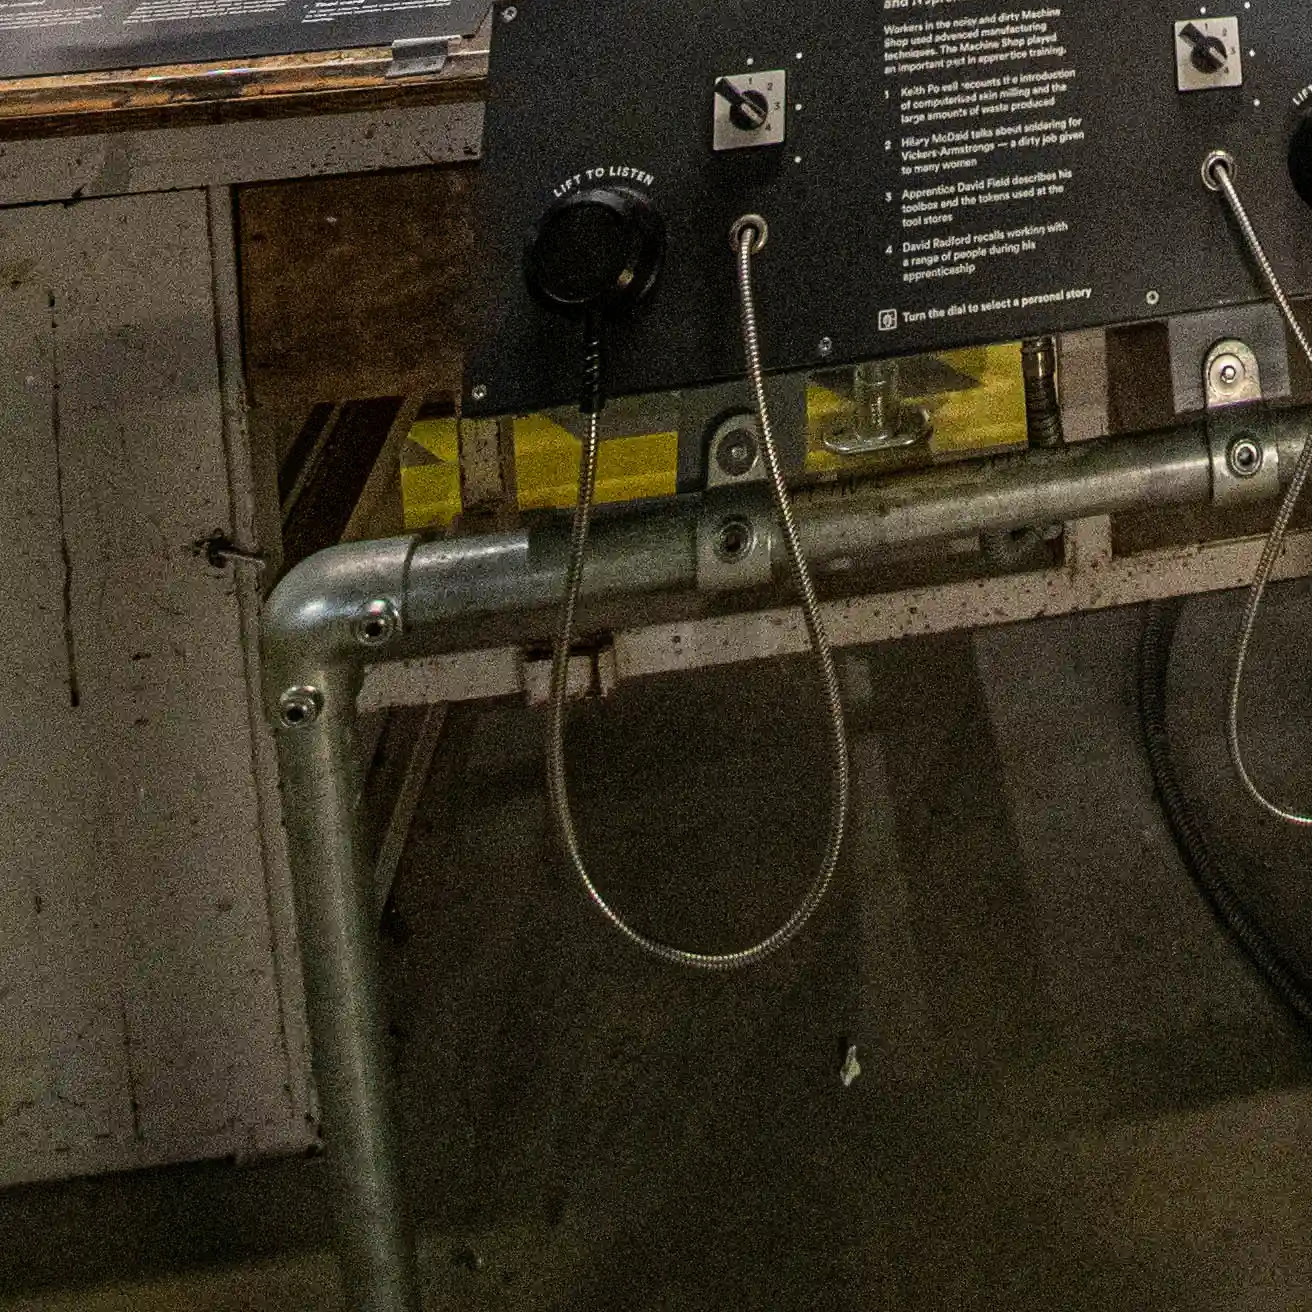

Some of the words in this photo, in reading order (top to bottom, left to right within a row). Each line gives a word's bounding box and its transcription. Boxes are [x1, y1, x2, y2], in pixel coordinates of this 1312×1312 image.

[883, 23, 923, 34] Workers
[924, 20, 934, 30] in
[935, 20, 951, 29] the
[978, 13, 996, 24] and
[997, 12, 1020, 22] dirty
[1021, 7, 1060, 19] Machine
[884, 37, 908, 48] Shop
[910, 33, 932, 44] used
[934, 28, 979, 42] advanced
[980, 22, 1046, 36] manufacturing
[939, 44, 958, 54] The
[959, 39, 999, 52] Machine
[1001, 37, 1025, 47] Shop
[1026, 32, 1057, 46] played
[884, 65, 896, 74] an
[898, 58, 944, 73] important
[967, 54, 976, 64] in
[978, 49, 1027, 64] apprentice
[884, 90, 889, 99] 1
[900, 85, 925, 96] Keith
[1002, 74, 1017, 84] the
[1018, 68, 1075, 82] introduction
[900, 99, 911, 110] of
[978, 89, 997, 100] skin
[1031, 83, 1049, 94] and
[1051, 82, 1066, 92] the
[900, 113, 925, 124] large
[927, 107, 967, 120] amounts
[969, 104, 979, 115] of
[980, 102, 1008, 114] waste
[1010, 96, 1055, 112] produced
[884, 140, 892, 150] 2
[970, 127, 993, 139] talks
[994, 123, 1022, 136] about
[1068, 117, 1082, 127] for
[1010, 139, 1016, 147] a
[1017, 135, 1040, 146] dirty
[1041, 132, 1057, 146] job
[1058, 131, 1084, 143] given
[900, 166, 912, 174] to
[913, 162, 940, 173] many
[941, 158, 977, 169] women
[553, 174, 581, 197] LIFT
[585, 167, 605, 180] TO
[609, 166, 654, 186] LISTEN
[885, 192, 892, 202] 3
[901, 183, 955, 200] Apprentice
[957, 179, 984, 192] David
[1011, 171, 1056, 185] describes
[1058, 168, 1072, 178] his
[901, 201, 938, 213] toolbox
[940, 195, 958, 208] and
[960, 195, 976, 205] the
[978, 191, 1010, 203] tokens
[1011, 186, 1034, 198] used
[1036, 186, 1046, 196] at
[1047, 184, 1064, 194] the
[902, 215, 921, 227] tool
[923, 213, 952, 224] stores
[885, 245, 893, 254] 4
[902, 239, 930, 252] David
[932, 233, 971, 248] Radford
[972, 229, 1004, 242] recalls
[1006, 225, 1045, 238] working
[1046, 221, 1068, 232] with
[902, 258, 909, 266] a
[910, 254, 939, 266] range
[940, 250, 951, 261] of
[953, 246, 986, 261] people
[988, 243, 1020, 255] during
[1021, 240, 1035, 250] his
[902, 264, 975, 280] apprenticeship
[902, 311, 926, 322] Turn
[927, 308, 945, 318] the
[947, 303, 966, 316] dial
[967, 303, 978, 313] to
[980, 298, 1011, 311] select
[1012, 298, 1019, 306] a
[1021, 290, 1064, 307] personal
[1065, 287, 1091, 299] story
